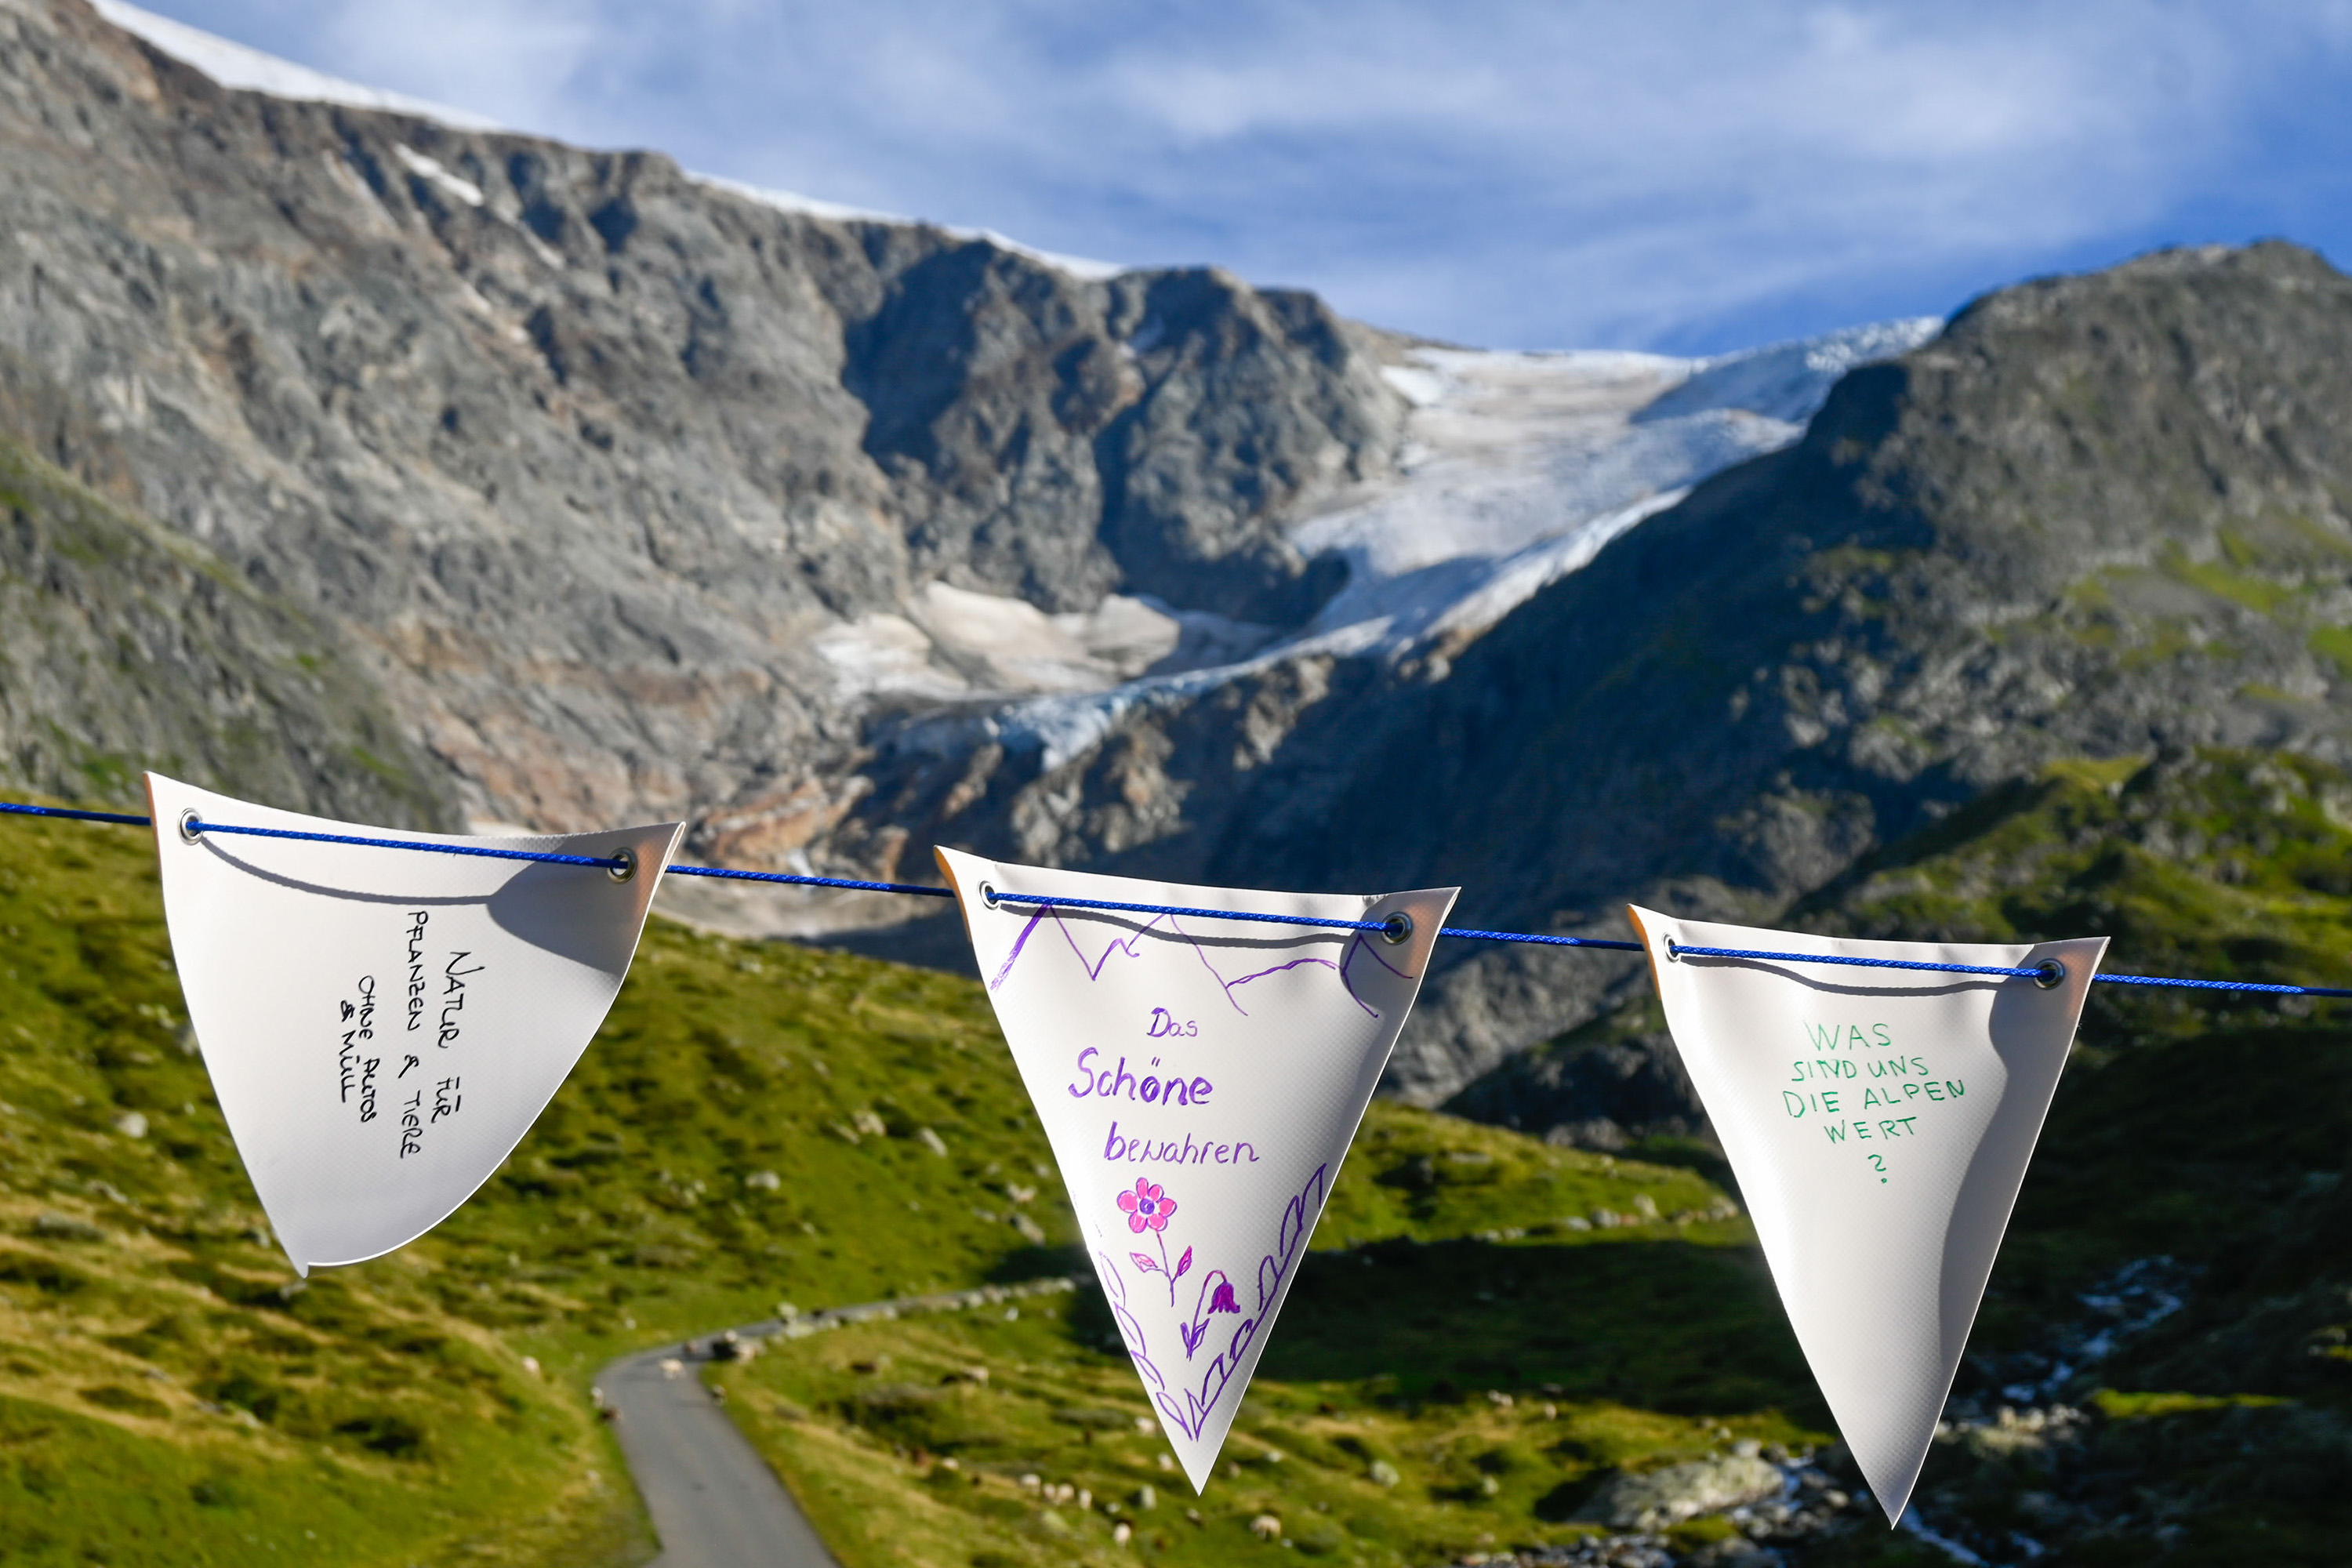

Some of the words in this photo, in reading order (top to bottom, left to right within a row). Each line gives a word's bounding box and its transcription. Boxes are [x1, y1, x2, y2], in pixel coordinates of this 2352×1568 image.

[406, 910, 429, 1031] PFLANZEN
[340, 1000, 355, 1022] &
[358, 975, 376, 1040] OHNE
[438, 951, 485, 1049] NATUR
[1146, 1007, 1198, 1037] Das
[1804, 1022, 1891, 1051] WAS
[339, 1030, 360, 1103] MÜLL
[397, 1054, 419, 1079] &
[1068, 1047, 1213, 1106] Schöne
[1791, 1058, 1857, 1082] SIND
[1867, 1055, 1929, 1078] UNS
[360, 1058, 380, 1123] AUTOS
[430, 1076, 461, 1123] FÜR
[1783, 1091, 1840, 1118] DIE
[1864, 1080, 1965, 1109] ALPEN
[400, 1090, 423, 1159] TIERE
[1104, 1120, 1260, 1164] bewahren
[1824, 1116, 1917, 1144] WERT
[1867, 1154, 1887, 1184] ?
